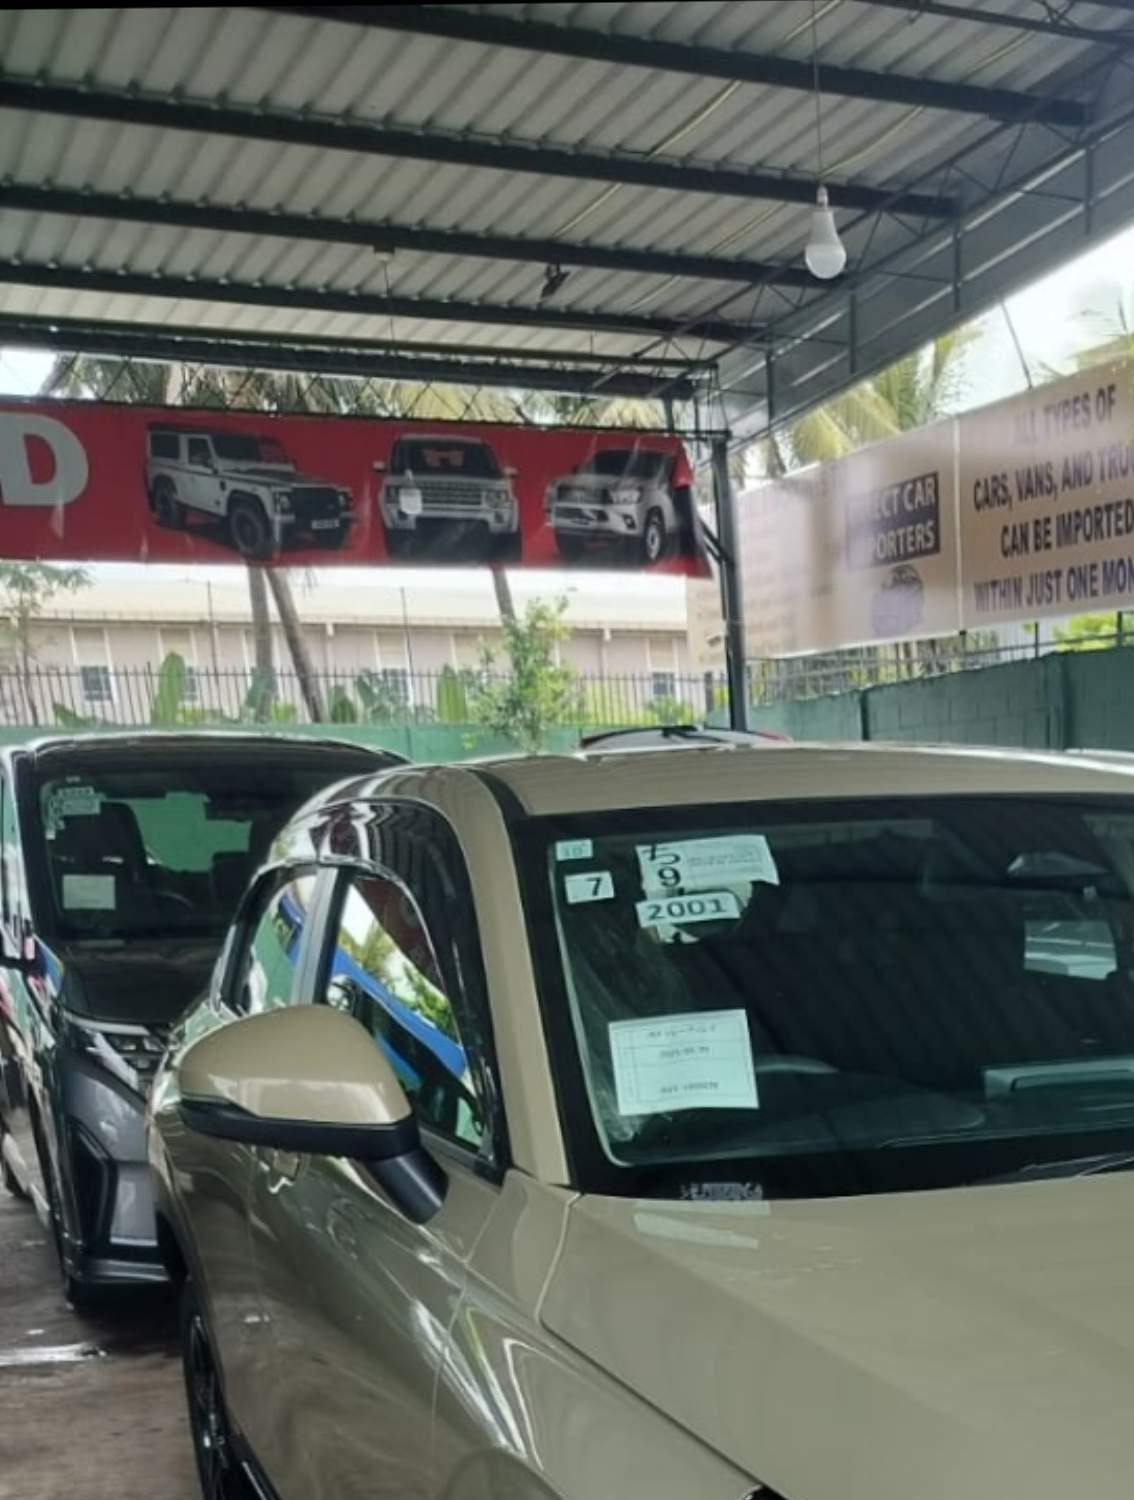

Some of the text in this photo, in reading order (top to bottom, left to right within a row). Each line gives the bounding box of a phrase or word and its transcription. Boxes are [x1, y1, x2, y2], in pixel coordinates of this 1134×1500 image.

[1042, 391, 1093, 434] TYPES
[1095, 384, 1118, 422] OF
[903, 476, 937, 512] CAR
[973, 472, 1013, 512] CARS,
[1015, 461, 1059, 502] VANS,
[1061, 450, 1094, 492] AND
[1001, 520, 1030, 559] CAN
[1033, 515, 1053, 552] BE
[973, 575, 1024, 613] WITHIN
[1026, 567, 1063, 606] JUST
[1066, 561, 1099, 602] ONE
[585, 877, 603, 897] 7
[647, 897, 727, 921] 2001
